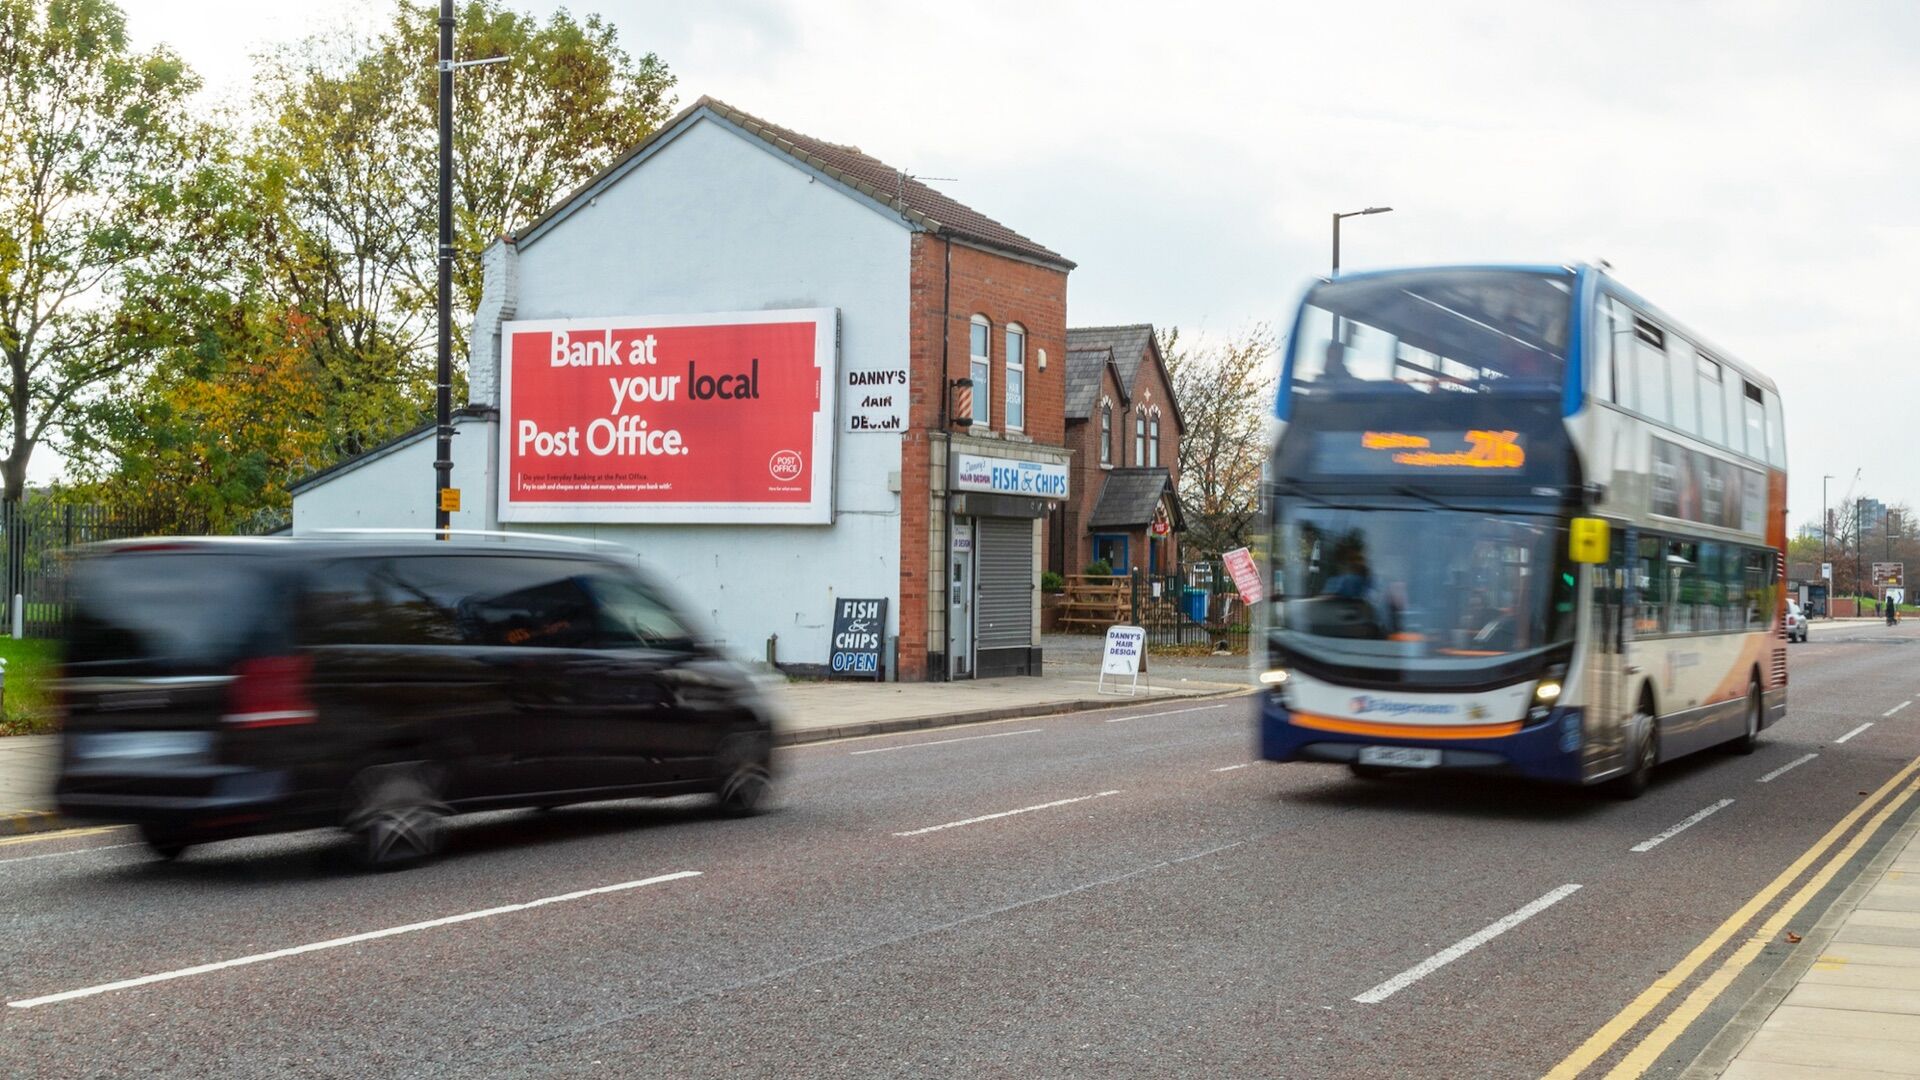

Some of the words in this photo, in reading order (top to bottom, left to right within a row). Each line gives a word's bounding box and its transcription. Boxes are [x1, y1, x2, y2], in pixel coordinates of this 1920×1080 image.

[550, 329, 622, 367] Bank
[628, 334, 657, 365] at
[849, 370, 906, 385] DANNY'S
[609, 375, 680, 415] your
[688, 358, 759, 400] local
[518, 419, 579, 456] Post
[586, 415, 689, 456] Office.
[772, 464, 798, 473] OFFICE
[777, 456, 796, 465] POST
[992, 467, 1019, 491] FISH
[1021, 471, 1033, 491] &
[1035, 473, 1065, 494] CHIPS
[843, 602, 878, 619] FISH
[848, 619, 870, 632] &
[836, 632, 878, 649] CHIPS
[1110, 632, 1141, 640] DANNY'S
[1116, 640, 1133, 648] HAIR
[1110, 648, 1136, 656] DESIGN
[832, 651, 878, 671] OPEN
